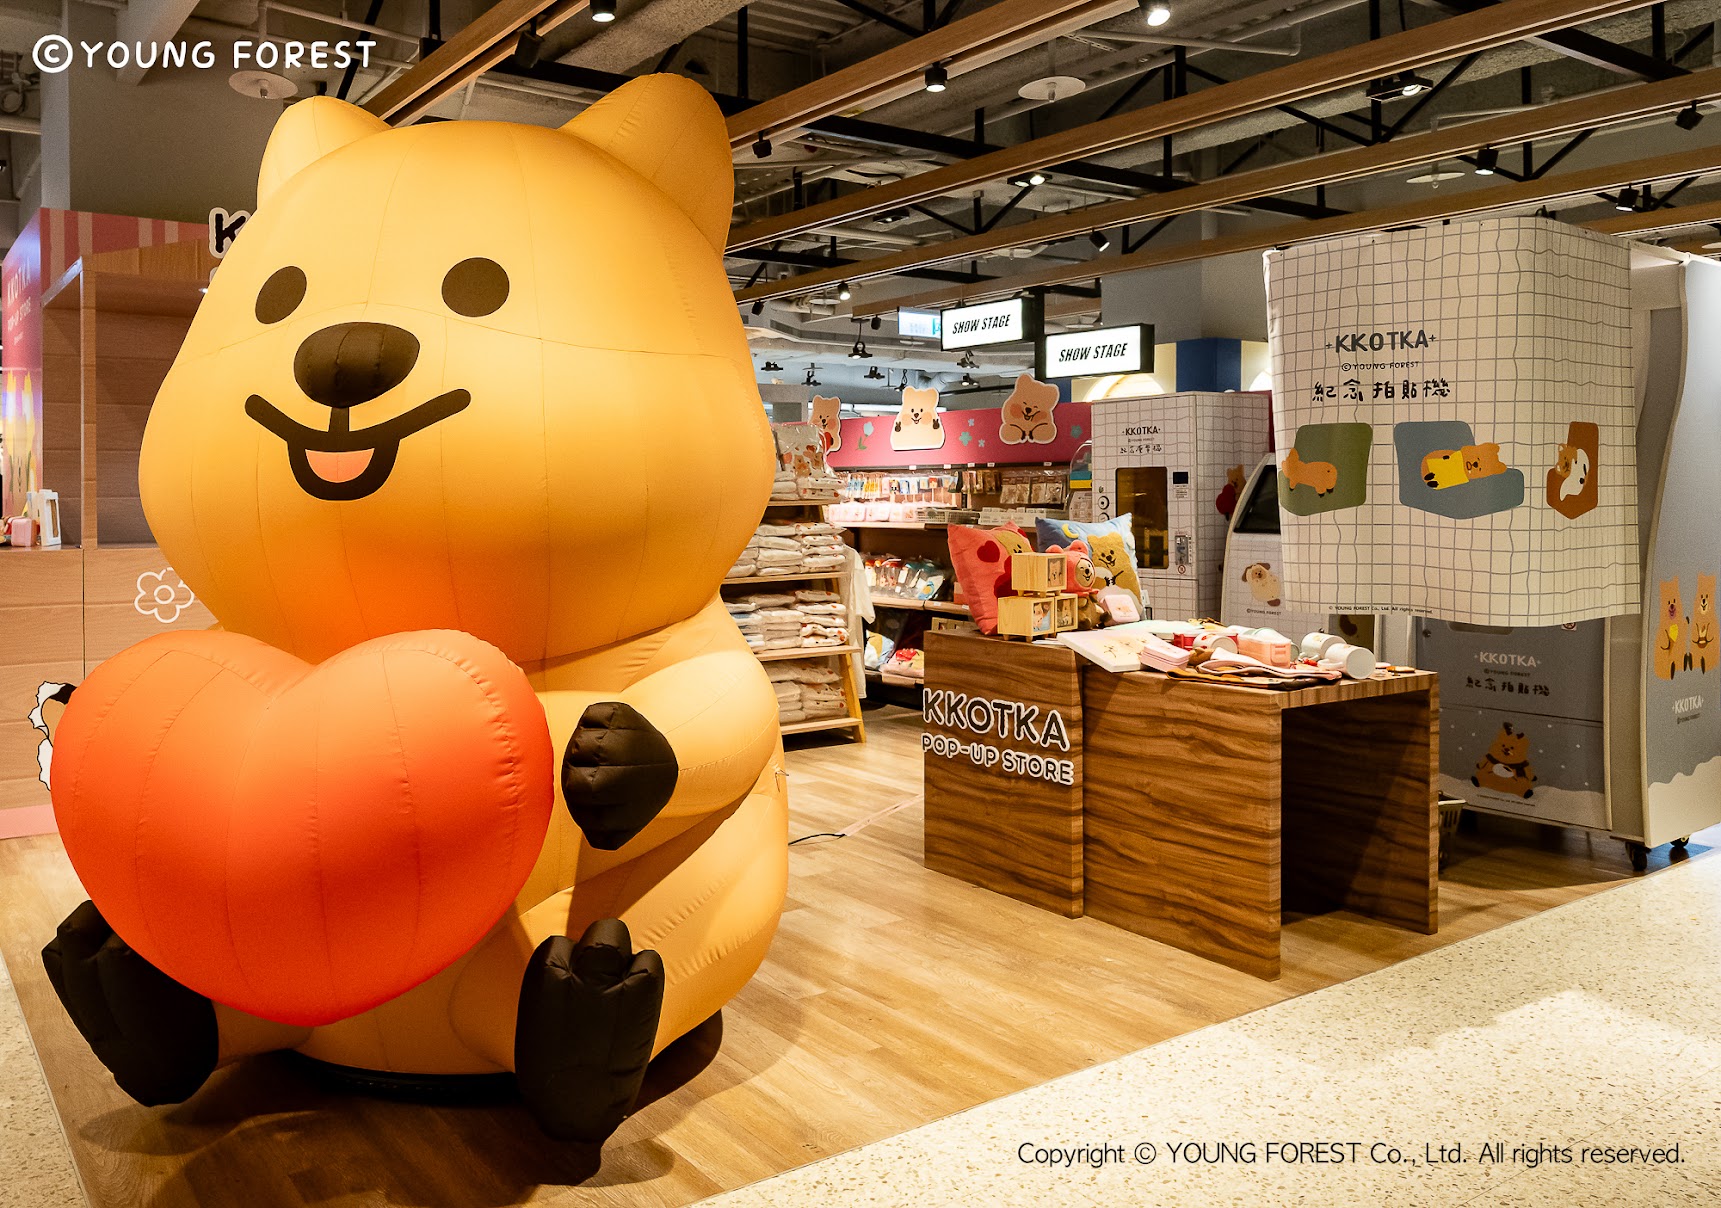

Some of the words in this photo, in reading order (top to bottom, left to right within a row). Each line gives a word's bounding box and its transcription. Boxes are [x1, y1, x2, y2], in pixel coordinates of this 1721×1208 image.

[952, 316, 980, 335] SHOW
[981, 313, 1011, 331] STAGE
[1058, 346, 1090, 362] SHOW
[1093, 342, 1129, 359] STAGE
[1335, 329, 1429, 353] KKOTKA
[1389, 361, 1419, 369] FOREST
[1312, 378, 1451, 402] 紀念拍貼機
[1125, 426, 1159, 436] KKOTKA
[1480, 651, 1537, 668] KKOTKA
[923, 688, 1070, 752] KKOTKA
[921, 733, 999, 767] POP-UP
[1001, 749, 1075, 785] STORE
